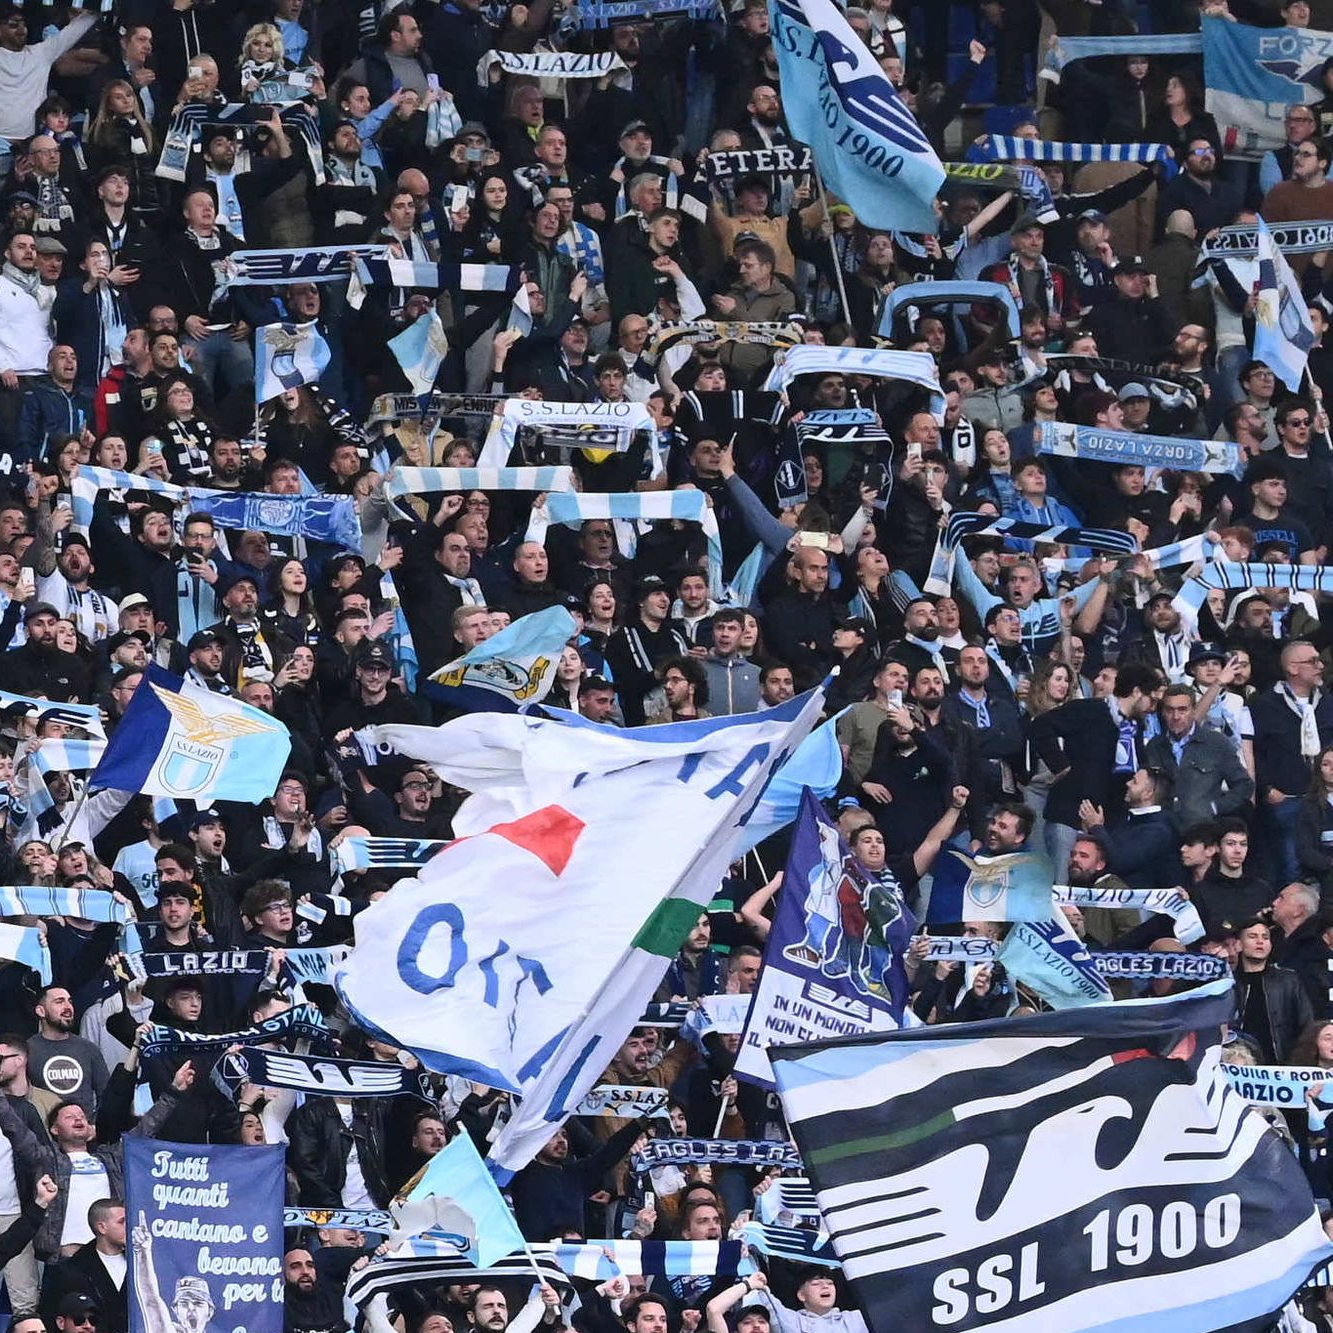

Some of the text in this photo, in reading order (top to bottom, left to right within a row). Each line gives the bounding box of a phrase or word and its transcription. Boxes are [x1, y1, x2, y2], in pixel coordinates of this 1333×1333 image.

[534, 51, 617, 74] LAZIO
[836, 128, 904, 178] 1900
[1088, 436, 1193, 460] LAZIO FORZA
[163, 952, 249, 971] LAZIO
[1032, 943, 1101, 1000] LAZIO 1900
[1096, 957, 1214, 974] AGLES LAZIO
[773, 994, 812, 1017] IN UN
[764, 1014, 794, 1035] NON
[47, 1067, 79, 1081] COLMAR
[1233, 1081, 1294, 1103] LAZIO
[640, 1144, 798, 1162] EAGLES LAZ
[150, 1149, 209, 1182] Tutti
[152, 1181, 231, 1210] quanti
[150, 1215, 269, 1245] cantano e
[197, 1245, 283, 1276] bevono
[931, 1191, 1242, 1326] SSL 1900
[222, 1279, 268, 1310] per
